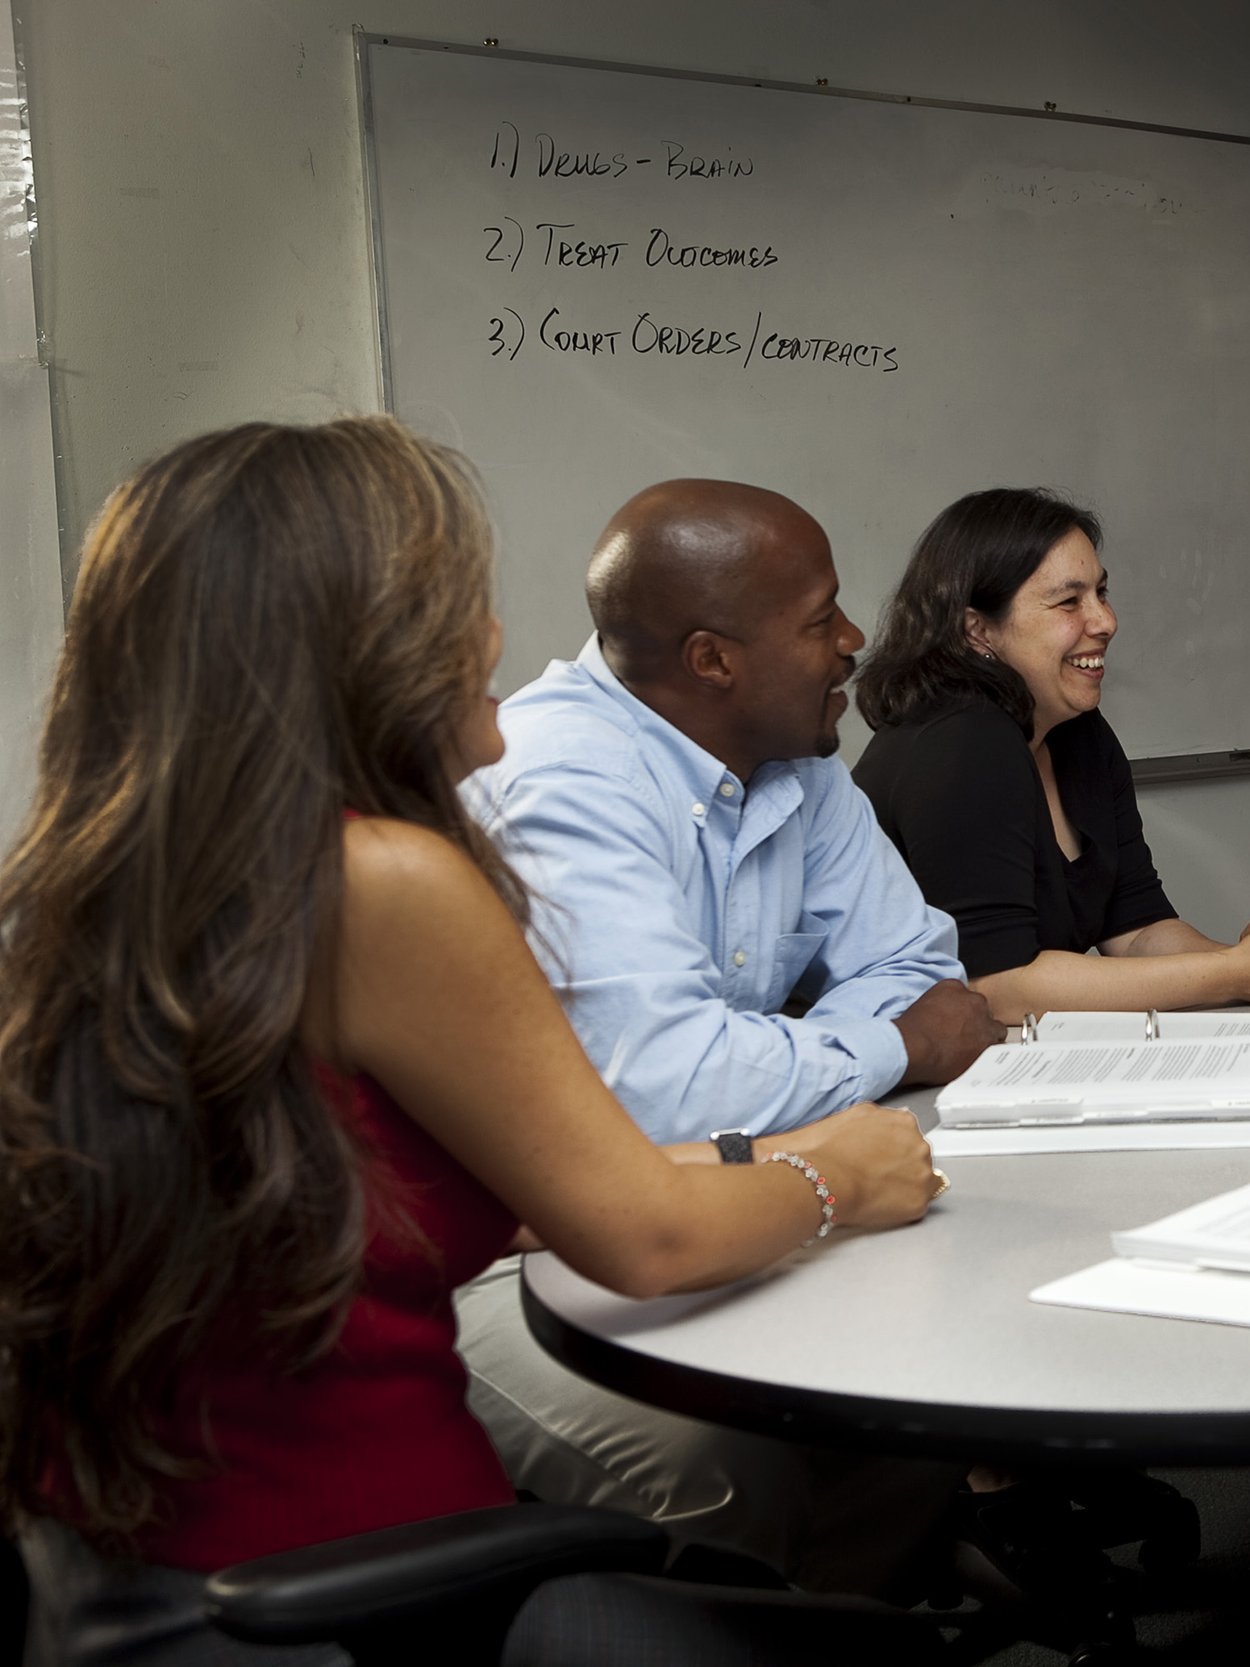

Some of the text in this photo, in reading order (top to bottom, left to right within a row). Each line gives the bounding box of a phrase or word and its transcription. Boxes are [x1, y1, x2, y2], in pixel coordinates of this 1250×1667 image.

[483, 216, 524, 272] 2.)
[536, 223, 629, 269] TREAT
[487, 307, 525, 361] 3.)
[539, 307, 622, 354] COURT
